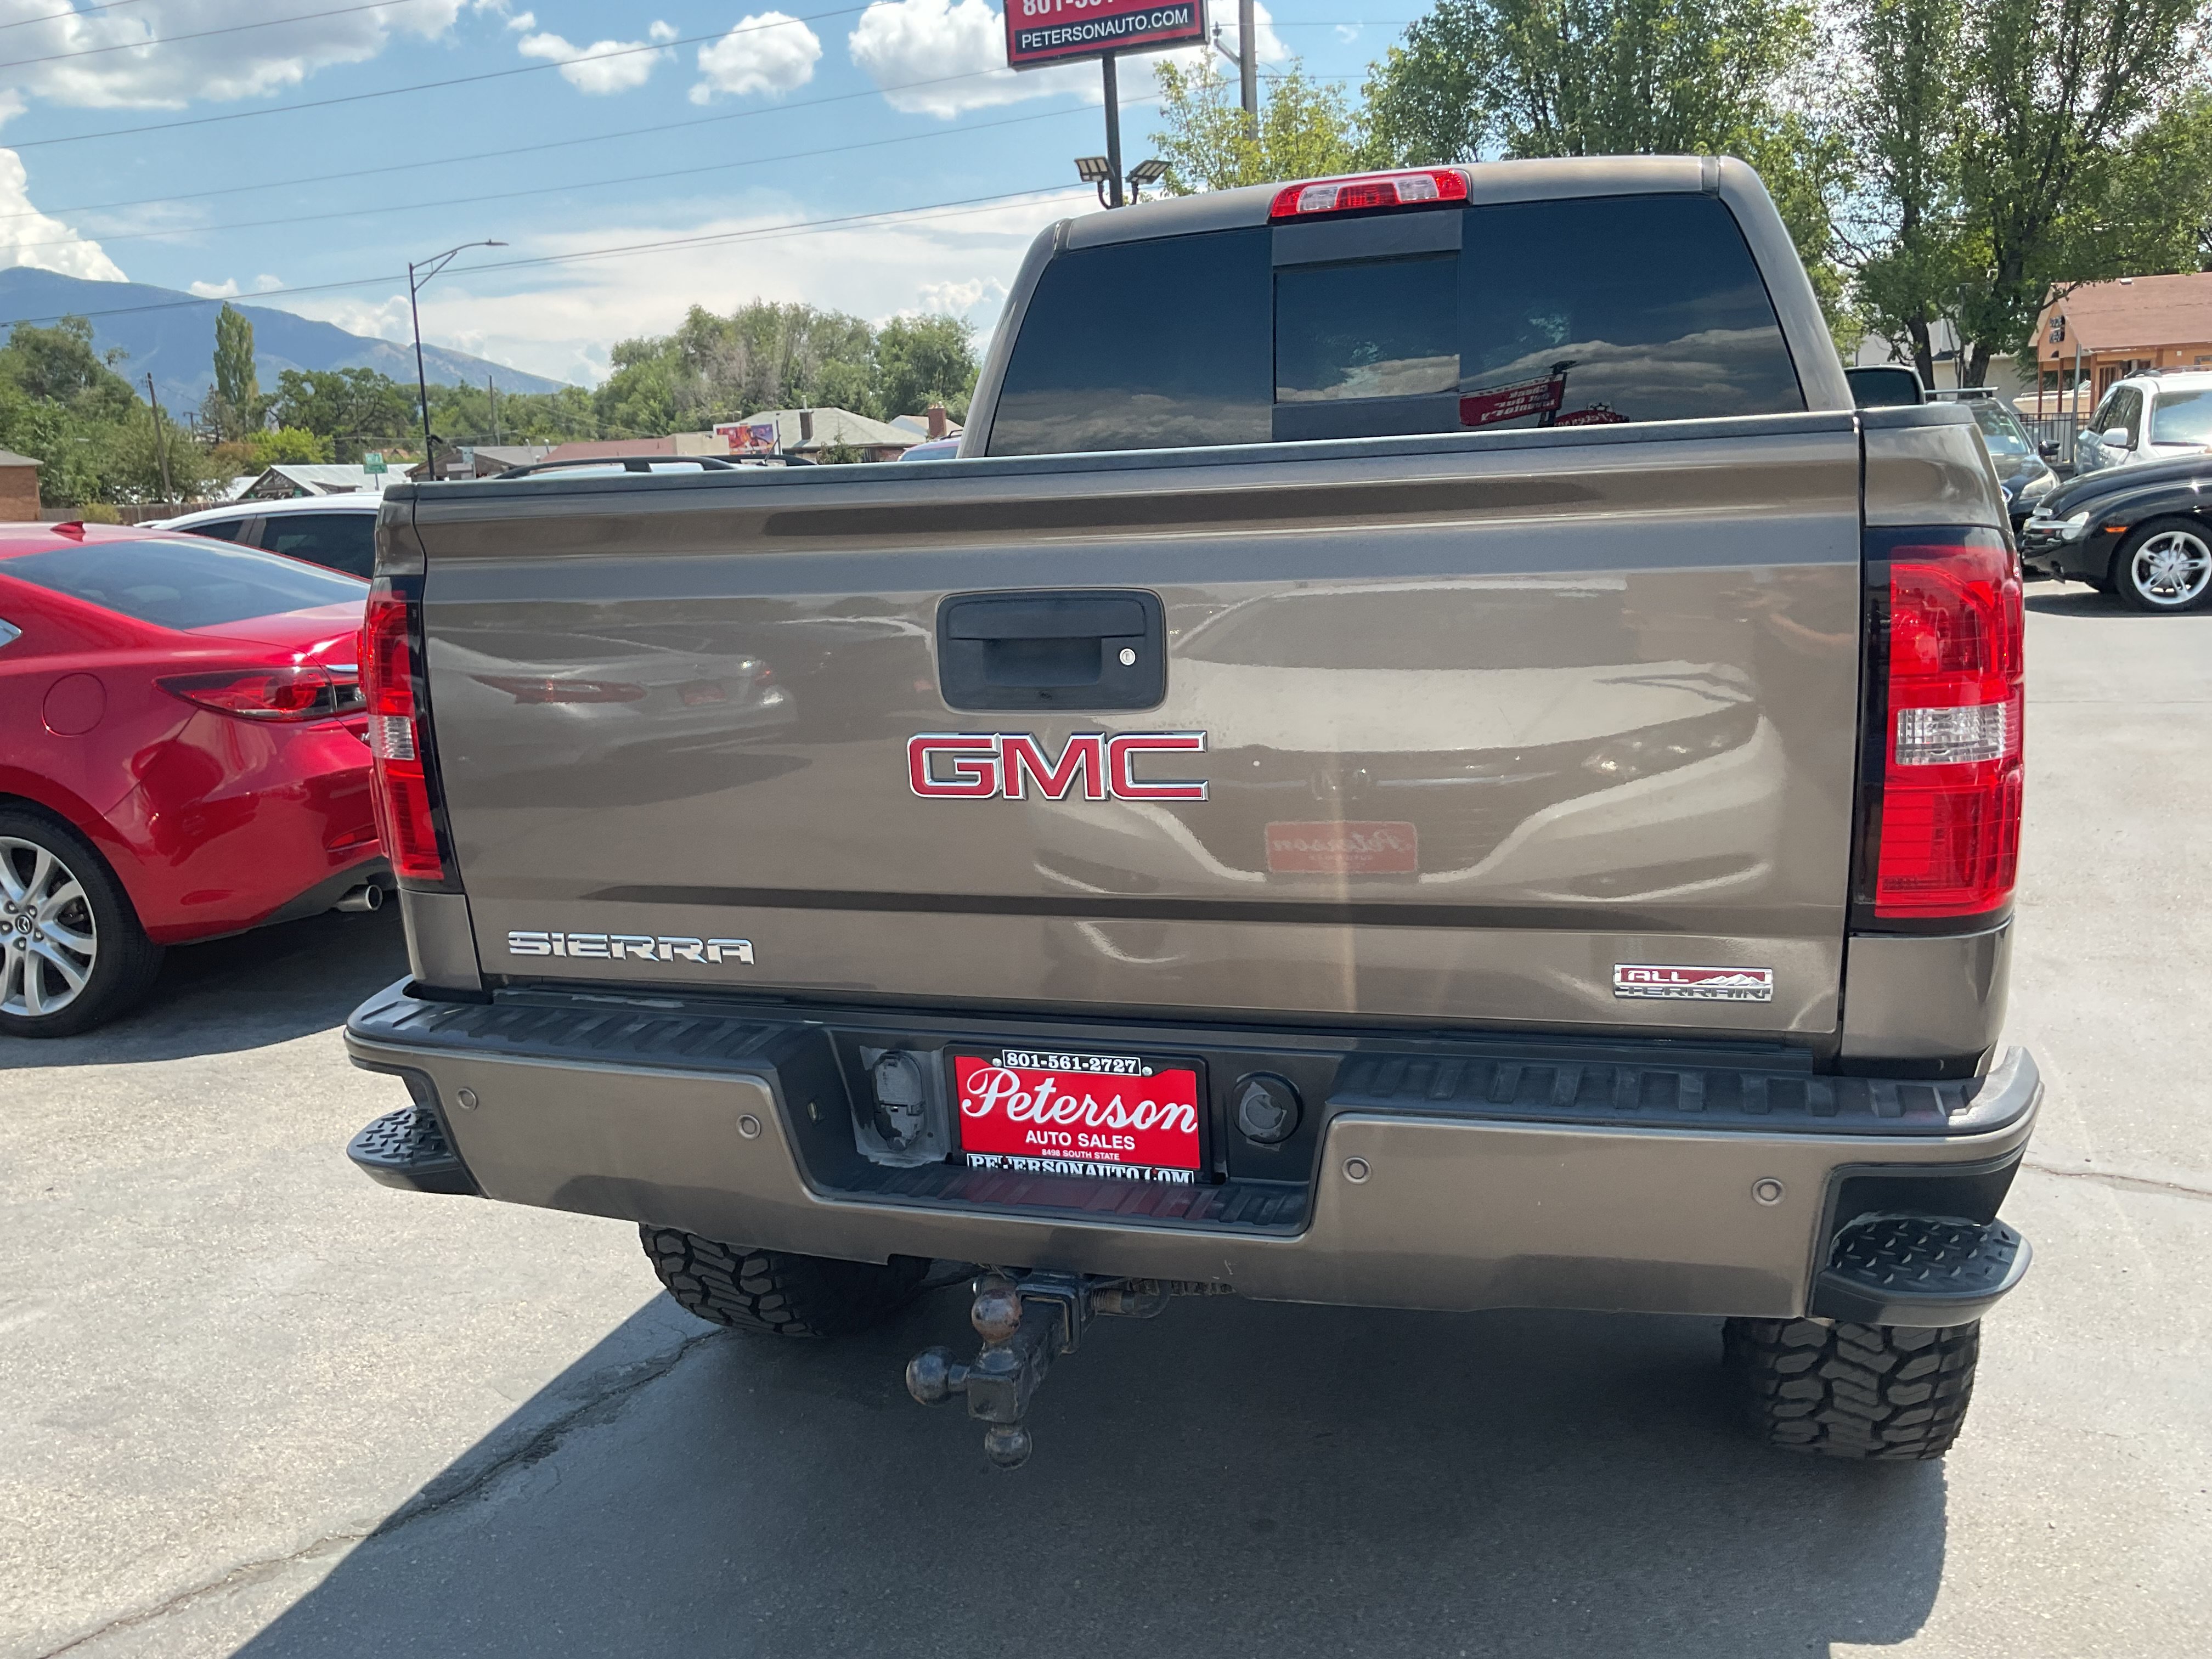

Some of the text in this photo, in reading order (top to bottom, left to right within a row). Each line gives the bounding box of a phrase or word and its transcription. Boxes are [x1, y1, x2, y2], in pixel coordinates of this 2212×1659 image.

[1021, 8, 1188, 48] PETERSONAUTO.COM
[907, 731, 1209, 801] GMC
[508, 931, 755, 965] SIERRA
[1628, 970, 1689, 982] ALL
[1615, 987, 1770, 999] TERRAIN
[1006, 1051, 1137, 1074] 801-561-2727
[962, 1067, 1198, 1133] Peterson
[1025, 1130, 1136, 1150] AUTO SALES
[1042, 1148, 1121, 1160] 8498 SOUTH STATE
